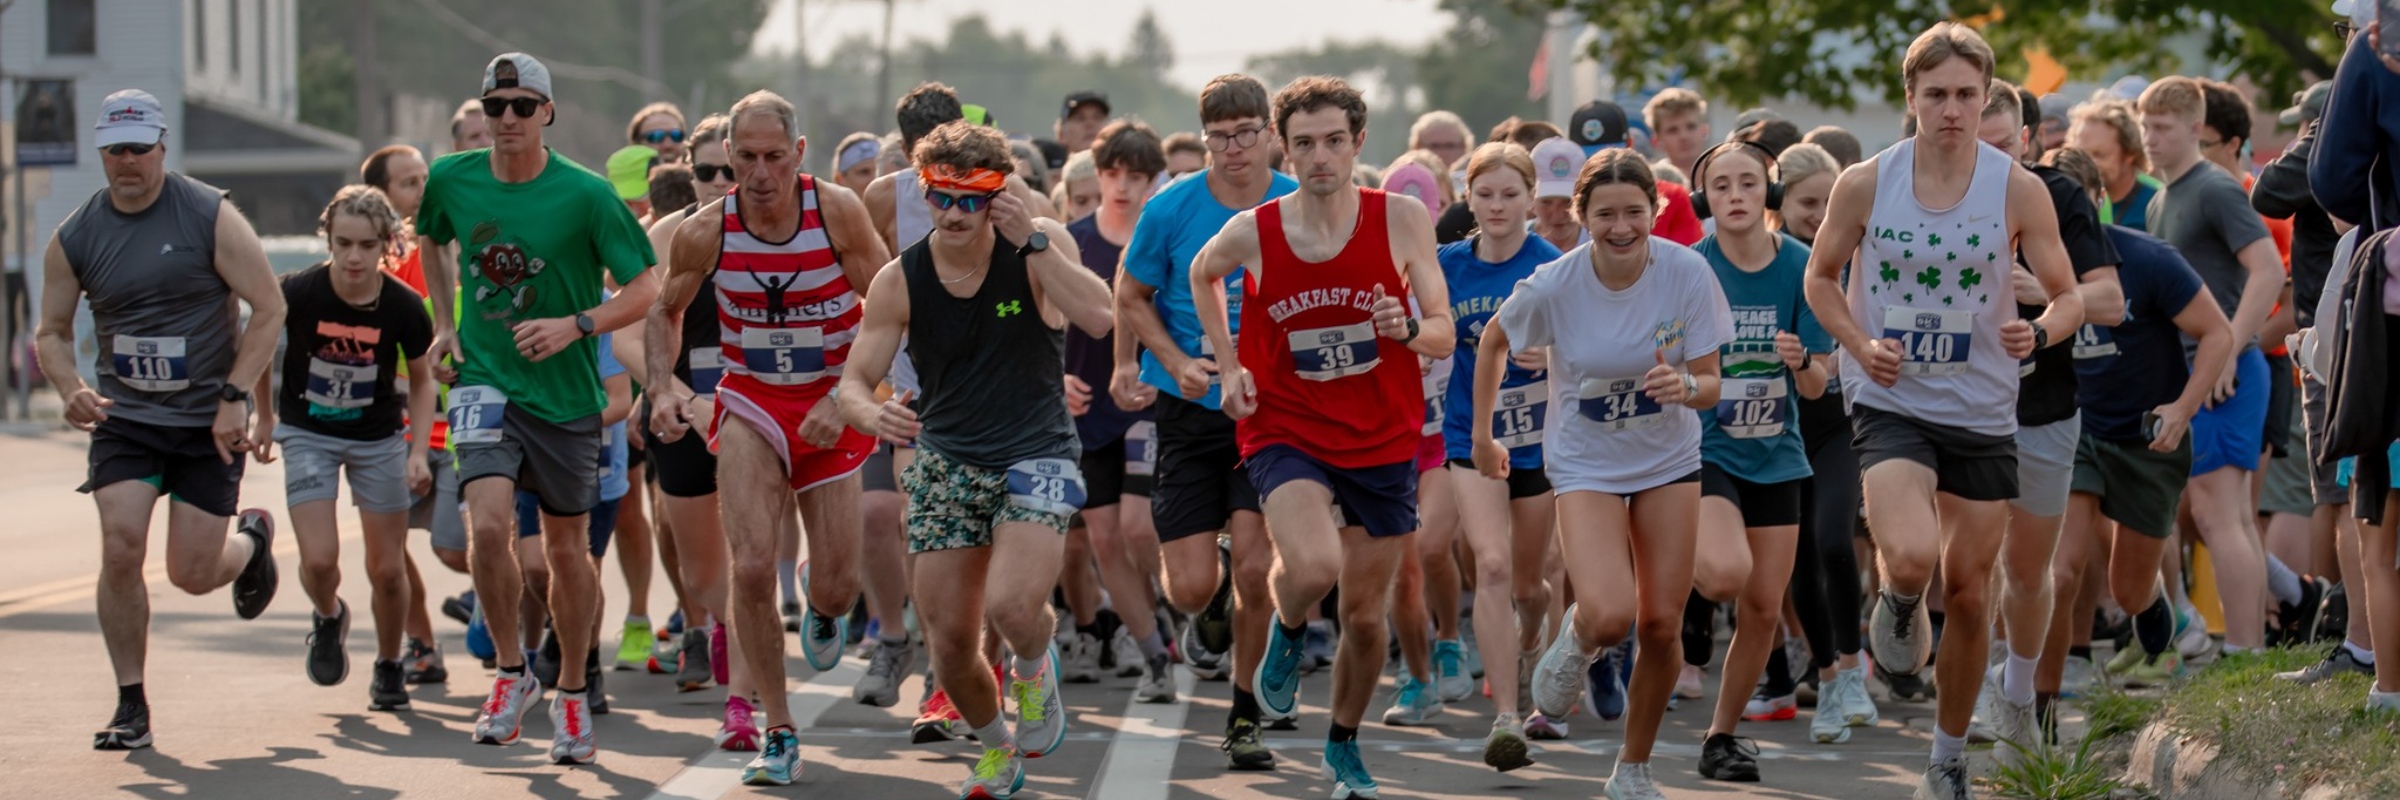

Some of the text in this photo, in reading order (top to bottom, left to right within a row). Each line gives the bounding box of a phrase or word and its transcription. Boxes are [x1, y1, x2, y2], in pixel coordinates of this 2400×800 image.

[1874, 226, 1914, 243] IAC
[1732, 310, 1777, 325] PEACE
[1317, 344, 1354, 370] 39
[1901, 331, 1954, 362] 140
[128, 356, 172, 380] 110
[775, 348, 793, 373] 5
[326, 380, 353, 400] 31
[453, 405, 482, 431] 16
[1603, 392, 1638, 421] 34
[1731, 399, 1776, 426] 102
[1501, 406, 1534, 436] 15
[1031, 475, 1065, 502] 28
